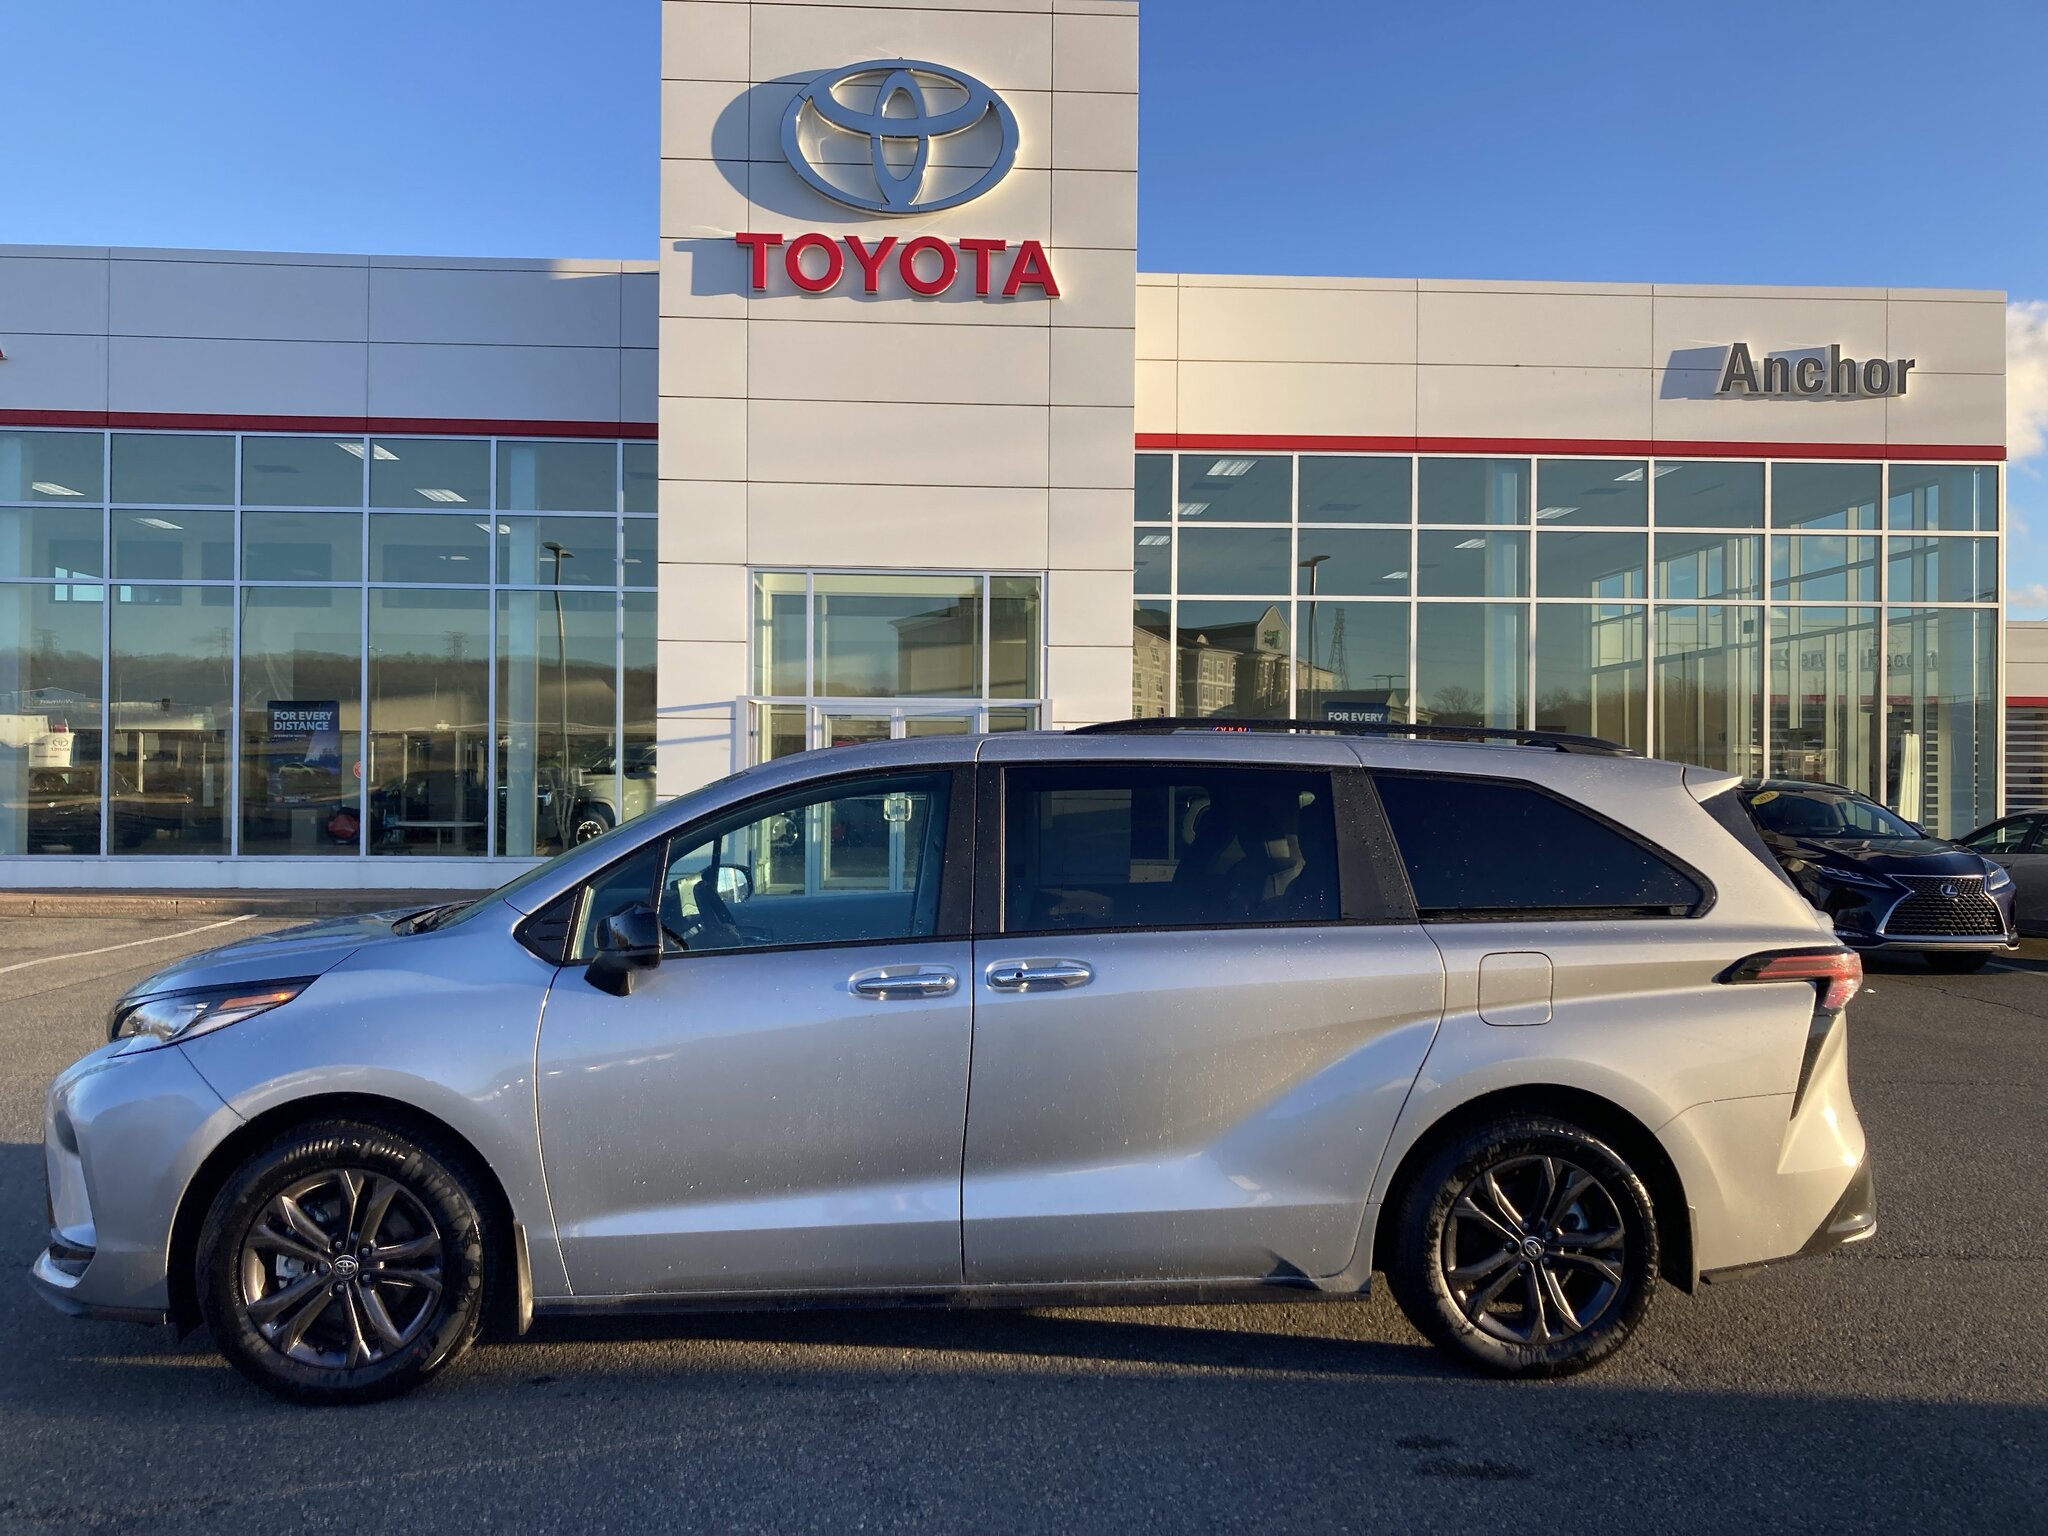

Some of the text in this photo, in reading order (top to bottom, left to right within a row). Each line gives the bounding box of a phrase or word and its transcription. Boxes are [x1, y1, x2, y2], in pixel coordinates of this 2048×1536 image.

[735, 232, 1061, 299] TOYOTA
[1717, 342, 1916, 396] Anchor
[273, 711, 333, 721] FOR EVERY
[1328, 711, 1384, 722] FOR EVERY
[273, 721, 329, 731] DISTANCE
